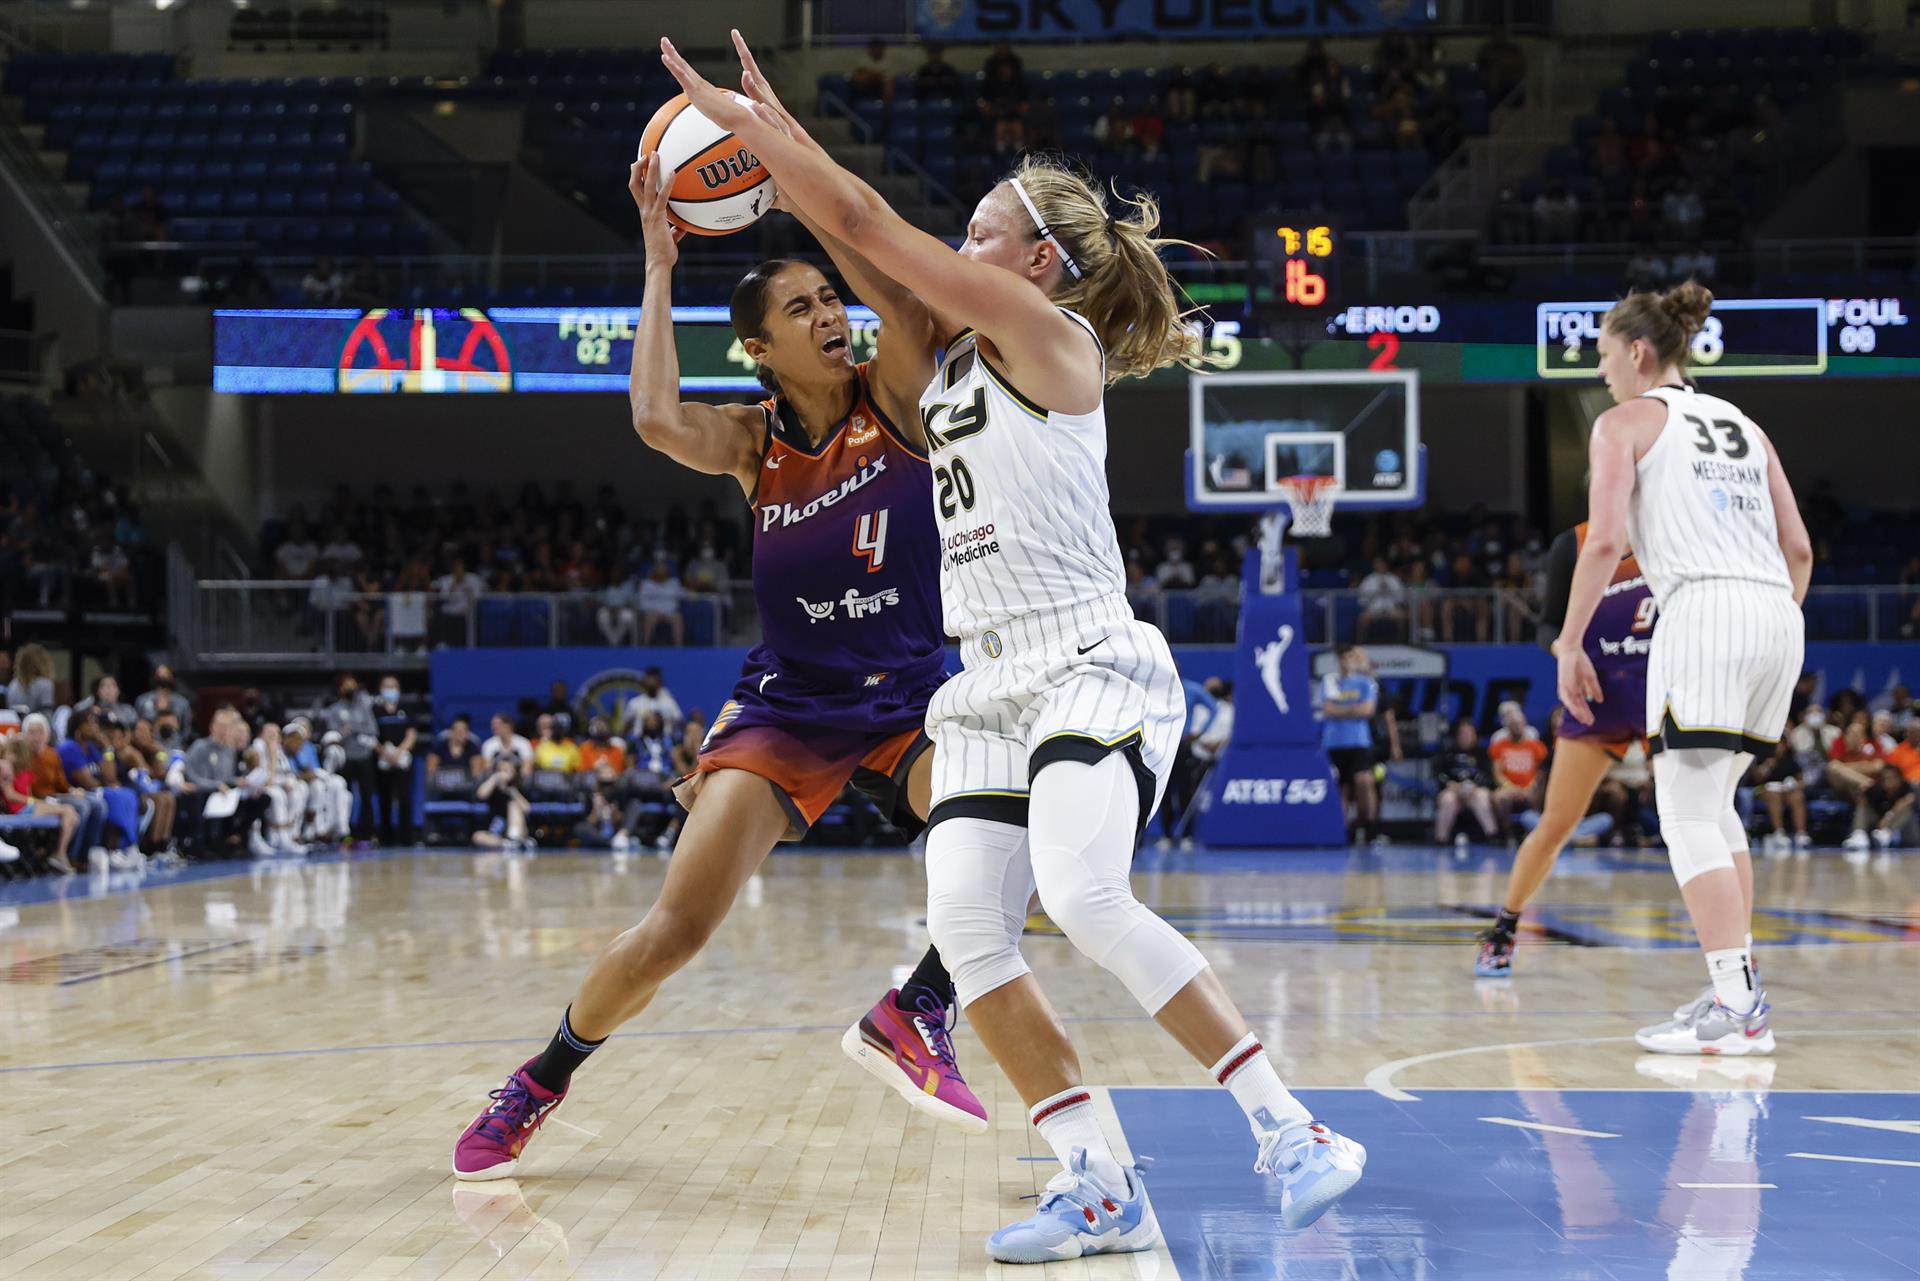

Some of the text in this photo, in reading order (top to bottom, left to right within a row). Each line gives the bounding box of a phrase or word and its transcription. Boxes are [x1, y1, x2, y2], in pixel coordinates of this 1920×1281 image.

[559, 313, 636, 340] FOUL
[1827, 299, 1908, 326] FOUL
[1367, 332, 1400, 370] 2
[847, 425, 878, 445] PayPal
[1683, 413, 1749, 459] 33
[761, 454, 887, 532] Phoenix
[934, 456, 975, 520] 20
[852, 508, 888, 573] 4
[948, 523, 995, 550] UChicago
[949, 540, 1000, 568] Medicine
[1632, 596, 1657, 632] 9
[1222, 779, 1286, 804] AT&T
